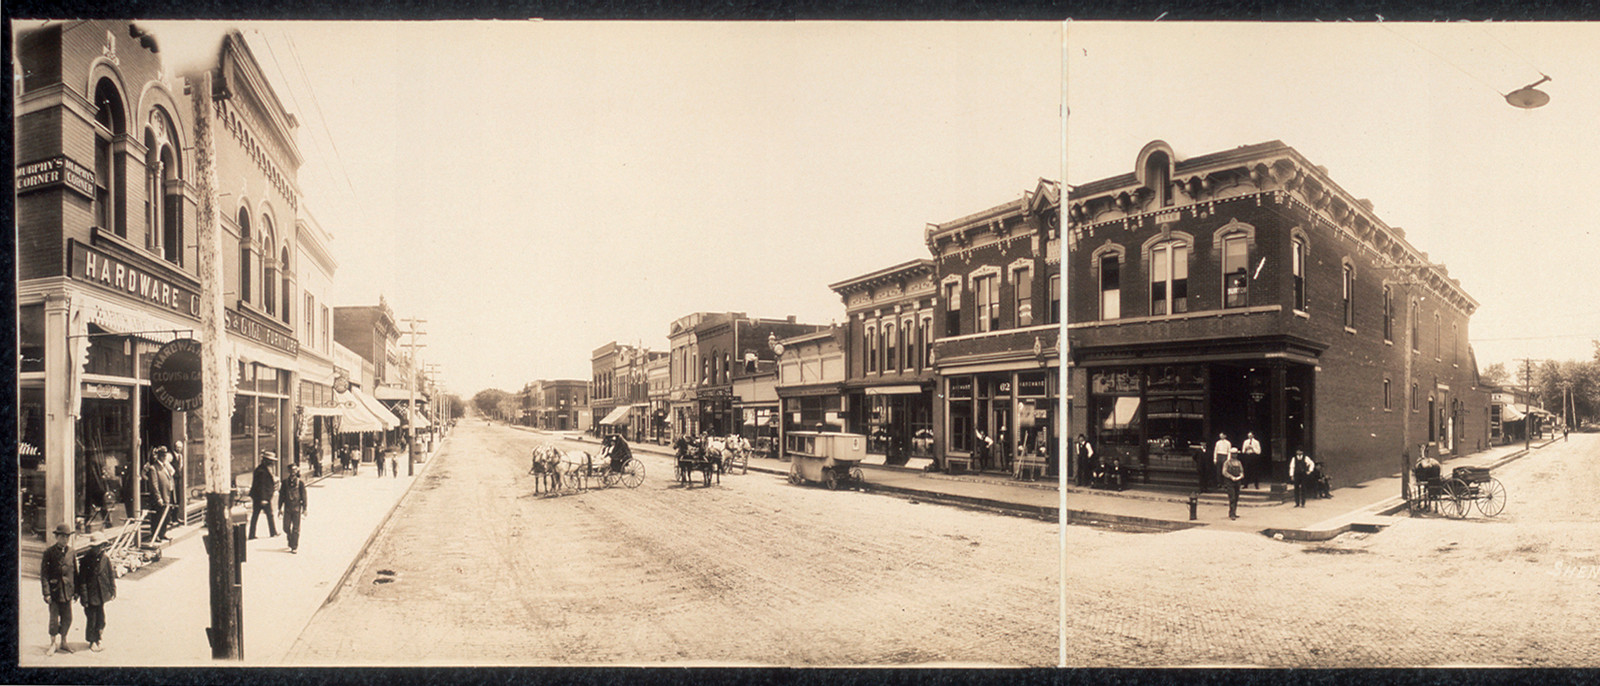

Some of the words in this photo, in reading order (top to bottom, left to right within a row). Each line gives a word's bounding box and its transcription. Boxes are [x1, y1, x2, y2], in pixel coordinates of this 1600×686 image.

[17, 171, 59, 189] CORNER
[67, 172, 93, 195] CORNER
[86, 251, 179, 308] HARDWARE
[999, 382, 1010, 391] 62
